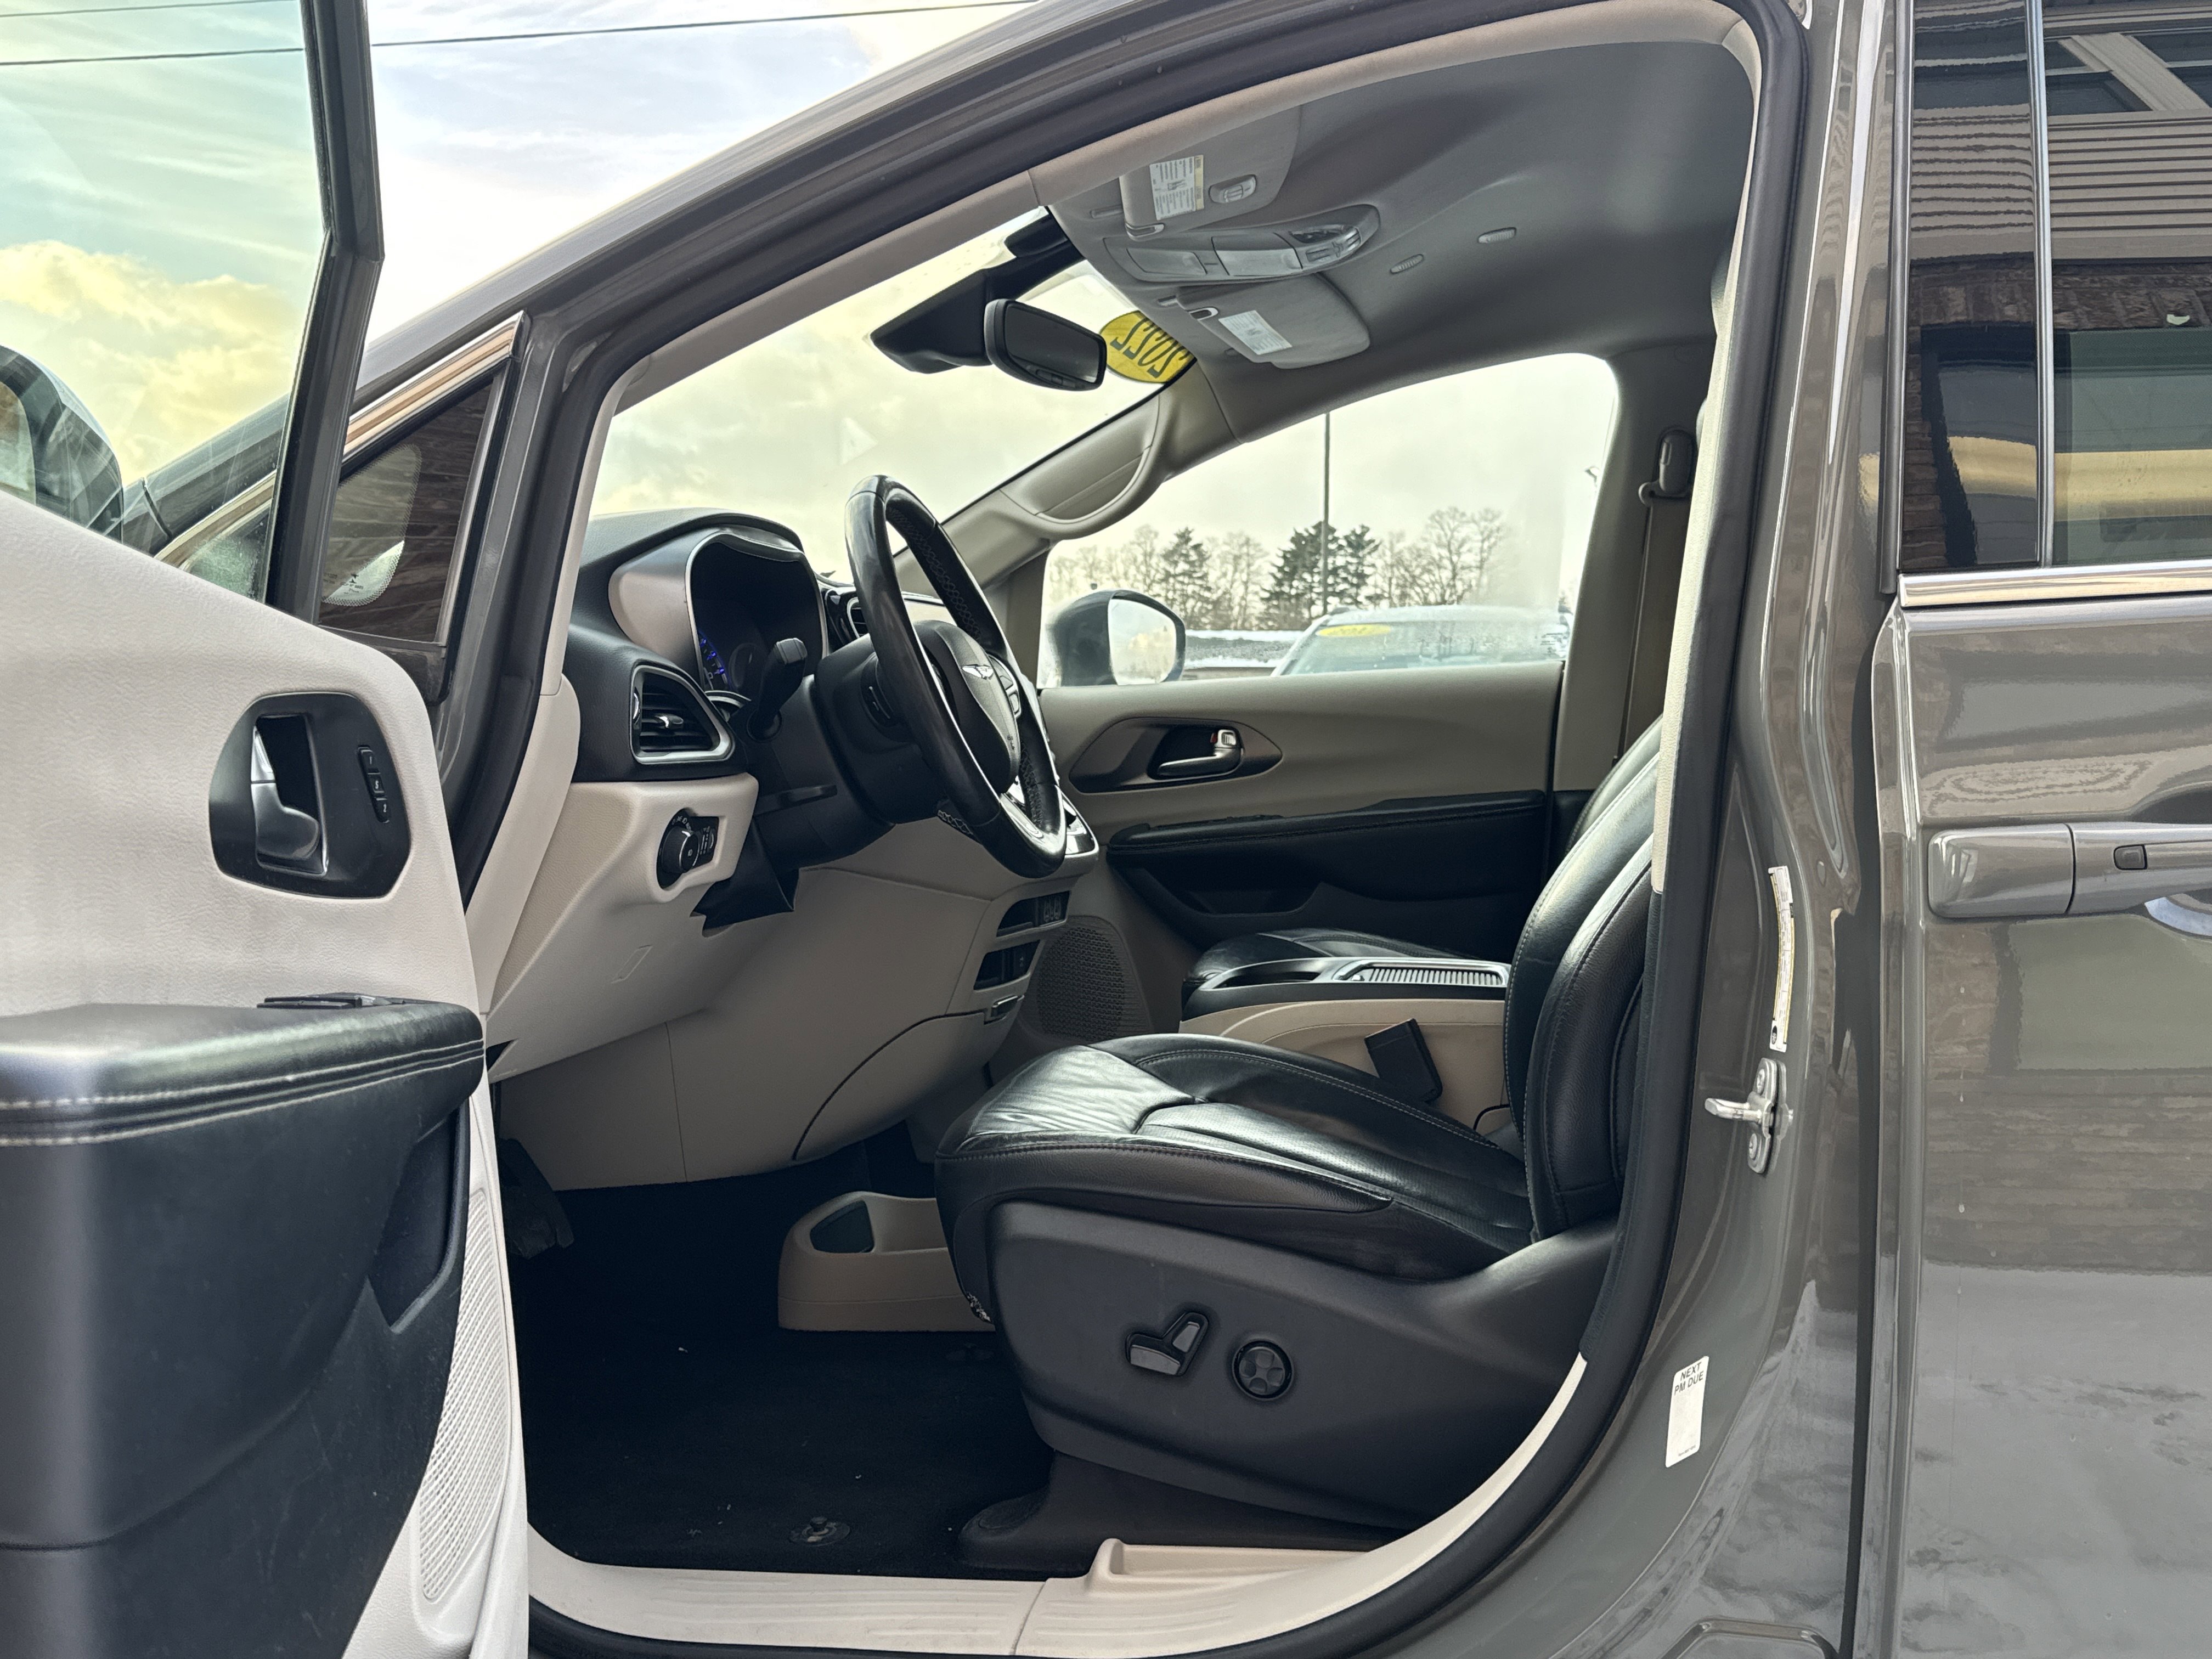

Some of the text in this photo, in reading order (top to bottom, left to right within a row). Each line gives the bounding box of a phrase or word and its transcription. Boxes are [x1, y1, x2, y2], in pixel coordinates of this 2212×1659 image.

[383, 804, 387, 812] 2
[1680, 1361, 1702, 1381] NEXT
[1674, 1370, 1705, 1396] PM DUE
